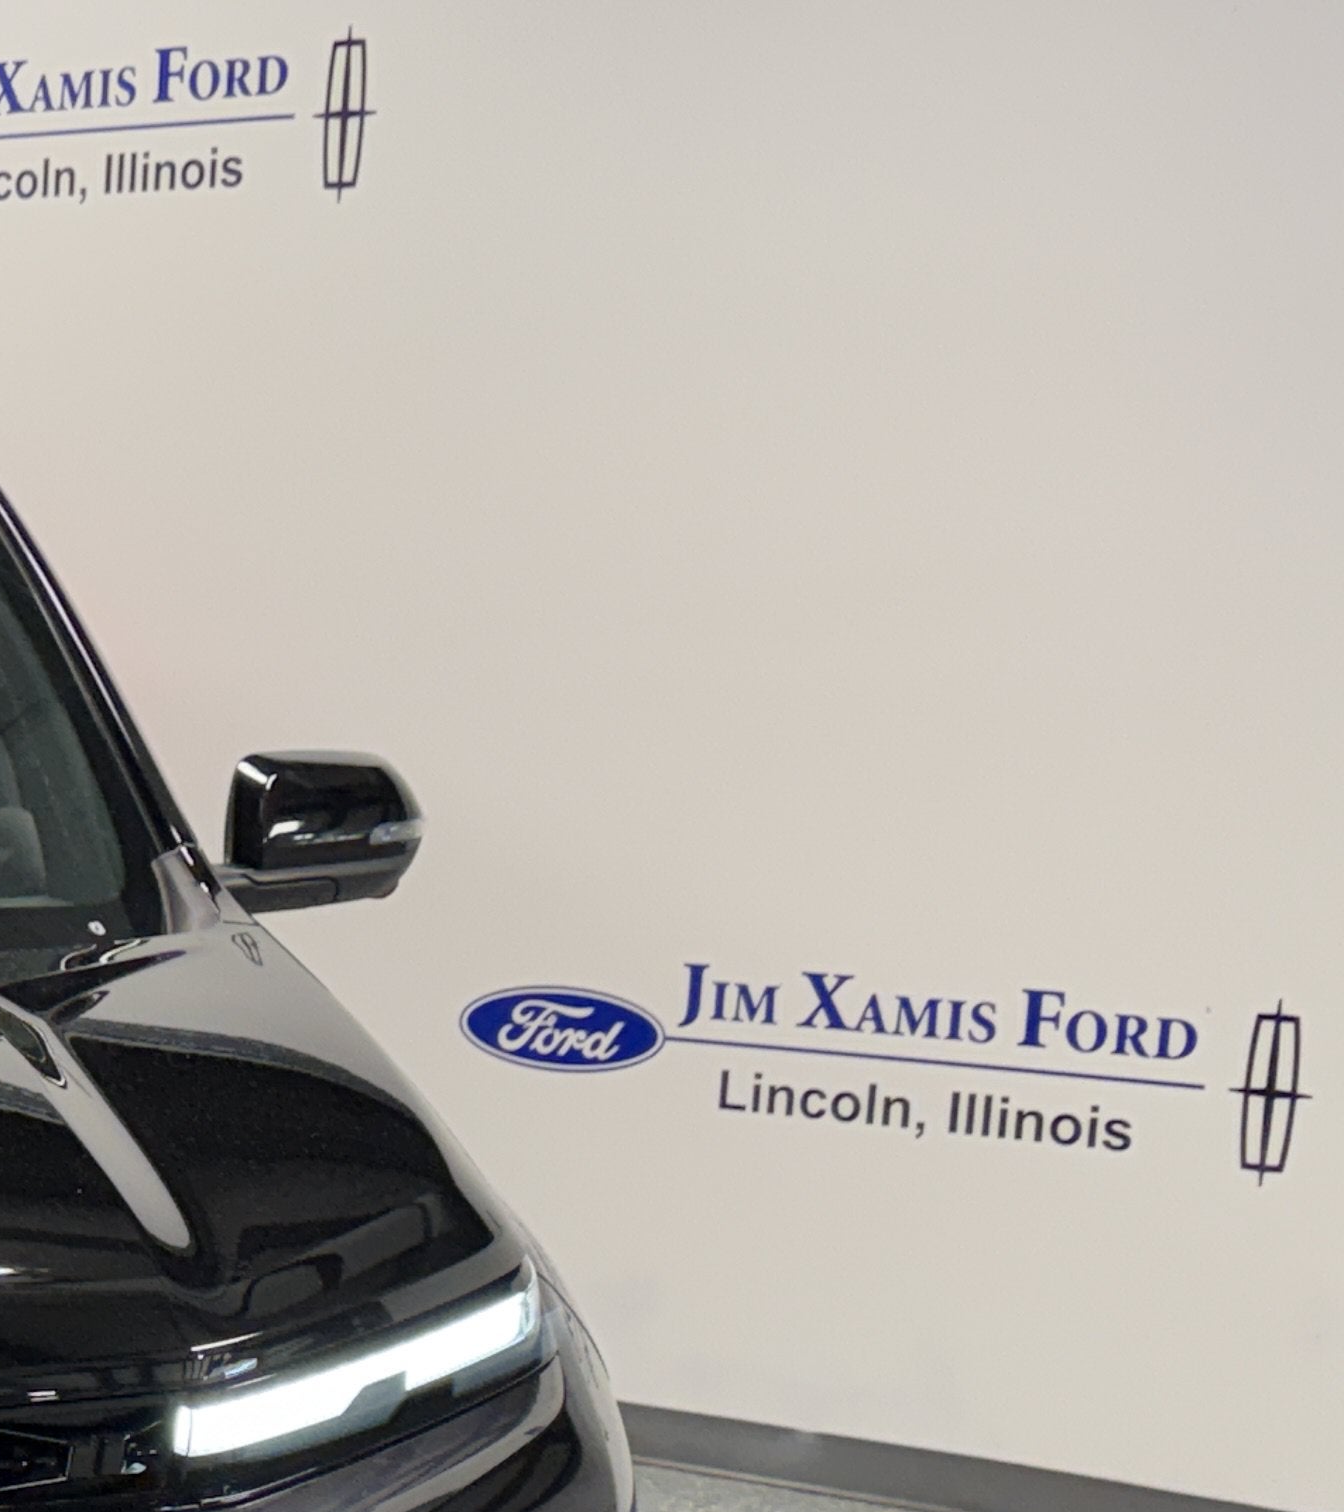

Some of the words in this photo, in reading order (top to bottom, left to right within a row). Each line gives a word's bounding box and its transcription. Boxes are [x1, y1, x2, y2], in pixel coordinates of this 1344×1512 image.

[153, 46, 289, 103] FORD
[104, 147, 243, 194] Illinois
[497, 1000, 621, 1064] Ford
[678, 963, 780, 1025] JIM
[796, 972, 997, 1044] XAMIS
[1017, 988, 1199, 1061] FORD
[718, 1070, 926, 1139] Lincoln,
[948, 1091, 1133, 1152] Illinois
